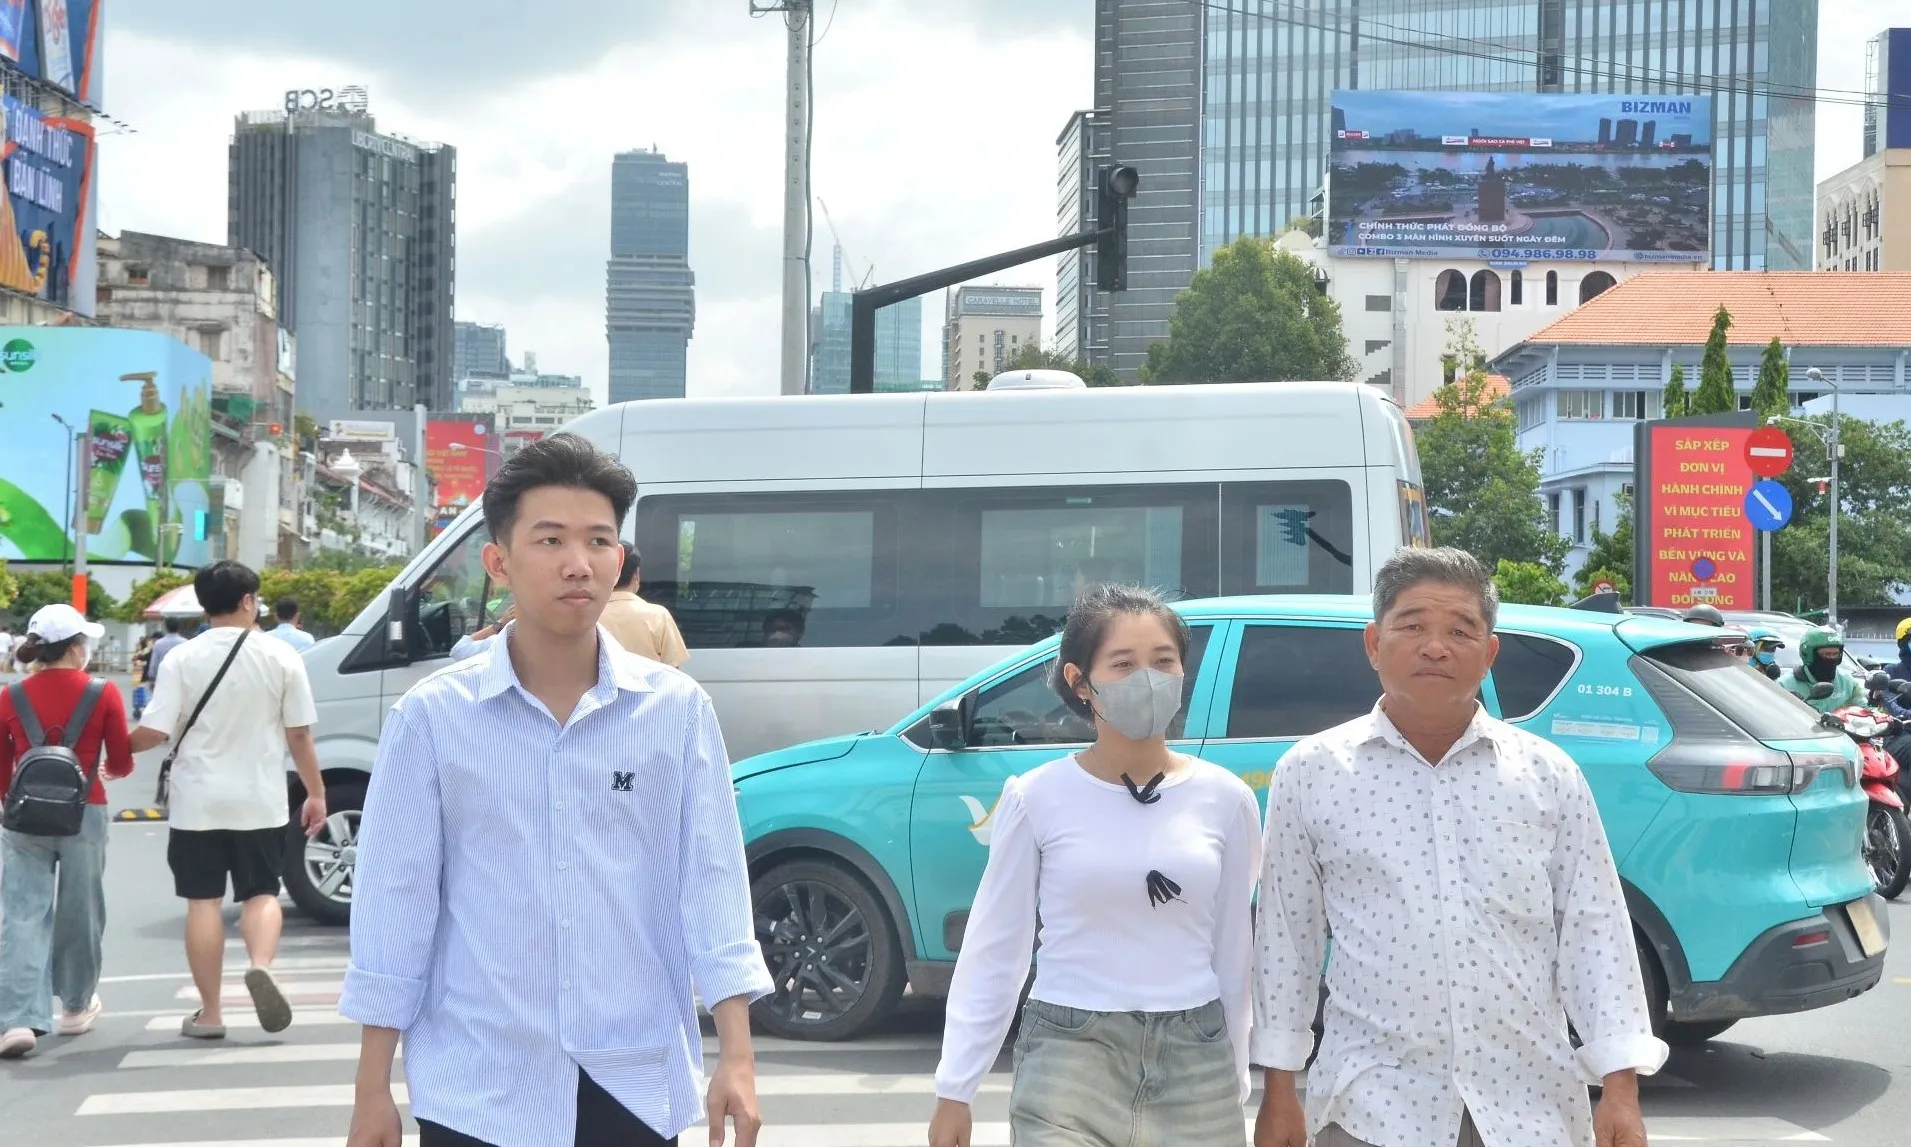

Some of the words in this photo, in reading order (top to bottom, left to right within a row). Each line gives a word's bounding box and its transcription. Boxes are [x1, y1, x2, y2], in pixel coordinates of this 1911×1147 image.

[1621, 101, 1691, 113] BIZMAN
[1359, 221, 1393, 230] CHÍNH
[1395, 221, 1425, 231] THỨC
[1426, 222, 1454, 231] PHÁT
[1456, 222, 1489, 232] ĐỒNG
[1491, 223, 1507, 233] BỘ
[1404, 232, 1425, 240] MÀN
[1454, 233, 1486, 242] XUYÊN
[1516, 234, 1542, 243] NGÀY
[1544, 235, 1566, 243] ĐÊM
[1491, 249, 1597, 259] 094.986.98.98
[1675, 436, 1702, 450] SẮP
[1703, 437, 1730, 451] XẾP
[1680, 461, 1708, 473] ĐƠN
[1710, 462, 1725, 475] VỊ
[1661, 481, 1700, 494] HÀNH
[1701, 482, 1743, 495] CHÍNH
[1679, 506, 1708, 519] MỤC
[1711, 504, 1741, 517] TIÊU
[1664, 526, 1699, 538] PHÁT
[1727, 549, 1746, 561] VÀ
[1669, 571, 1697, 582] NÂN
[1577, 684, 1593, 694] 01
[1596, 685, 1619, 696] 304
[1622, 687, 1632, 697] B
[611, 771, 635, 791] M
